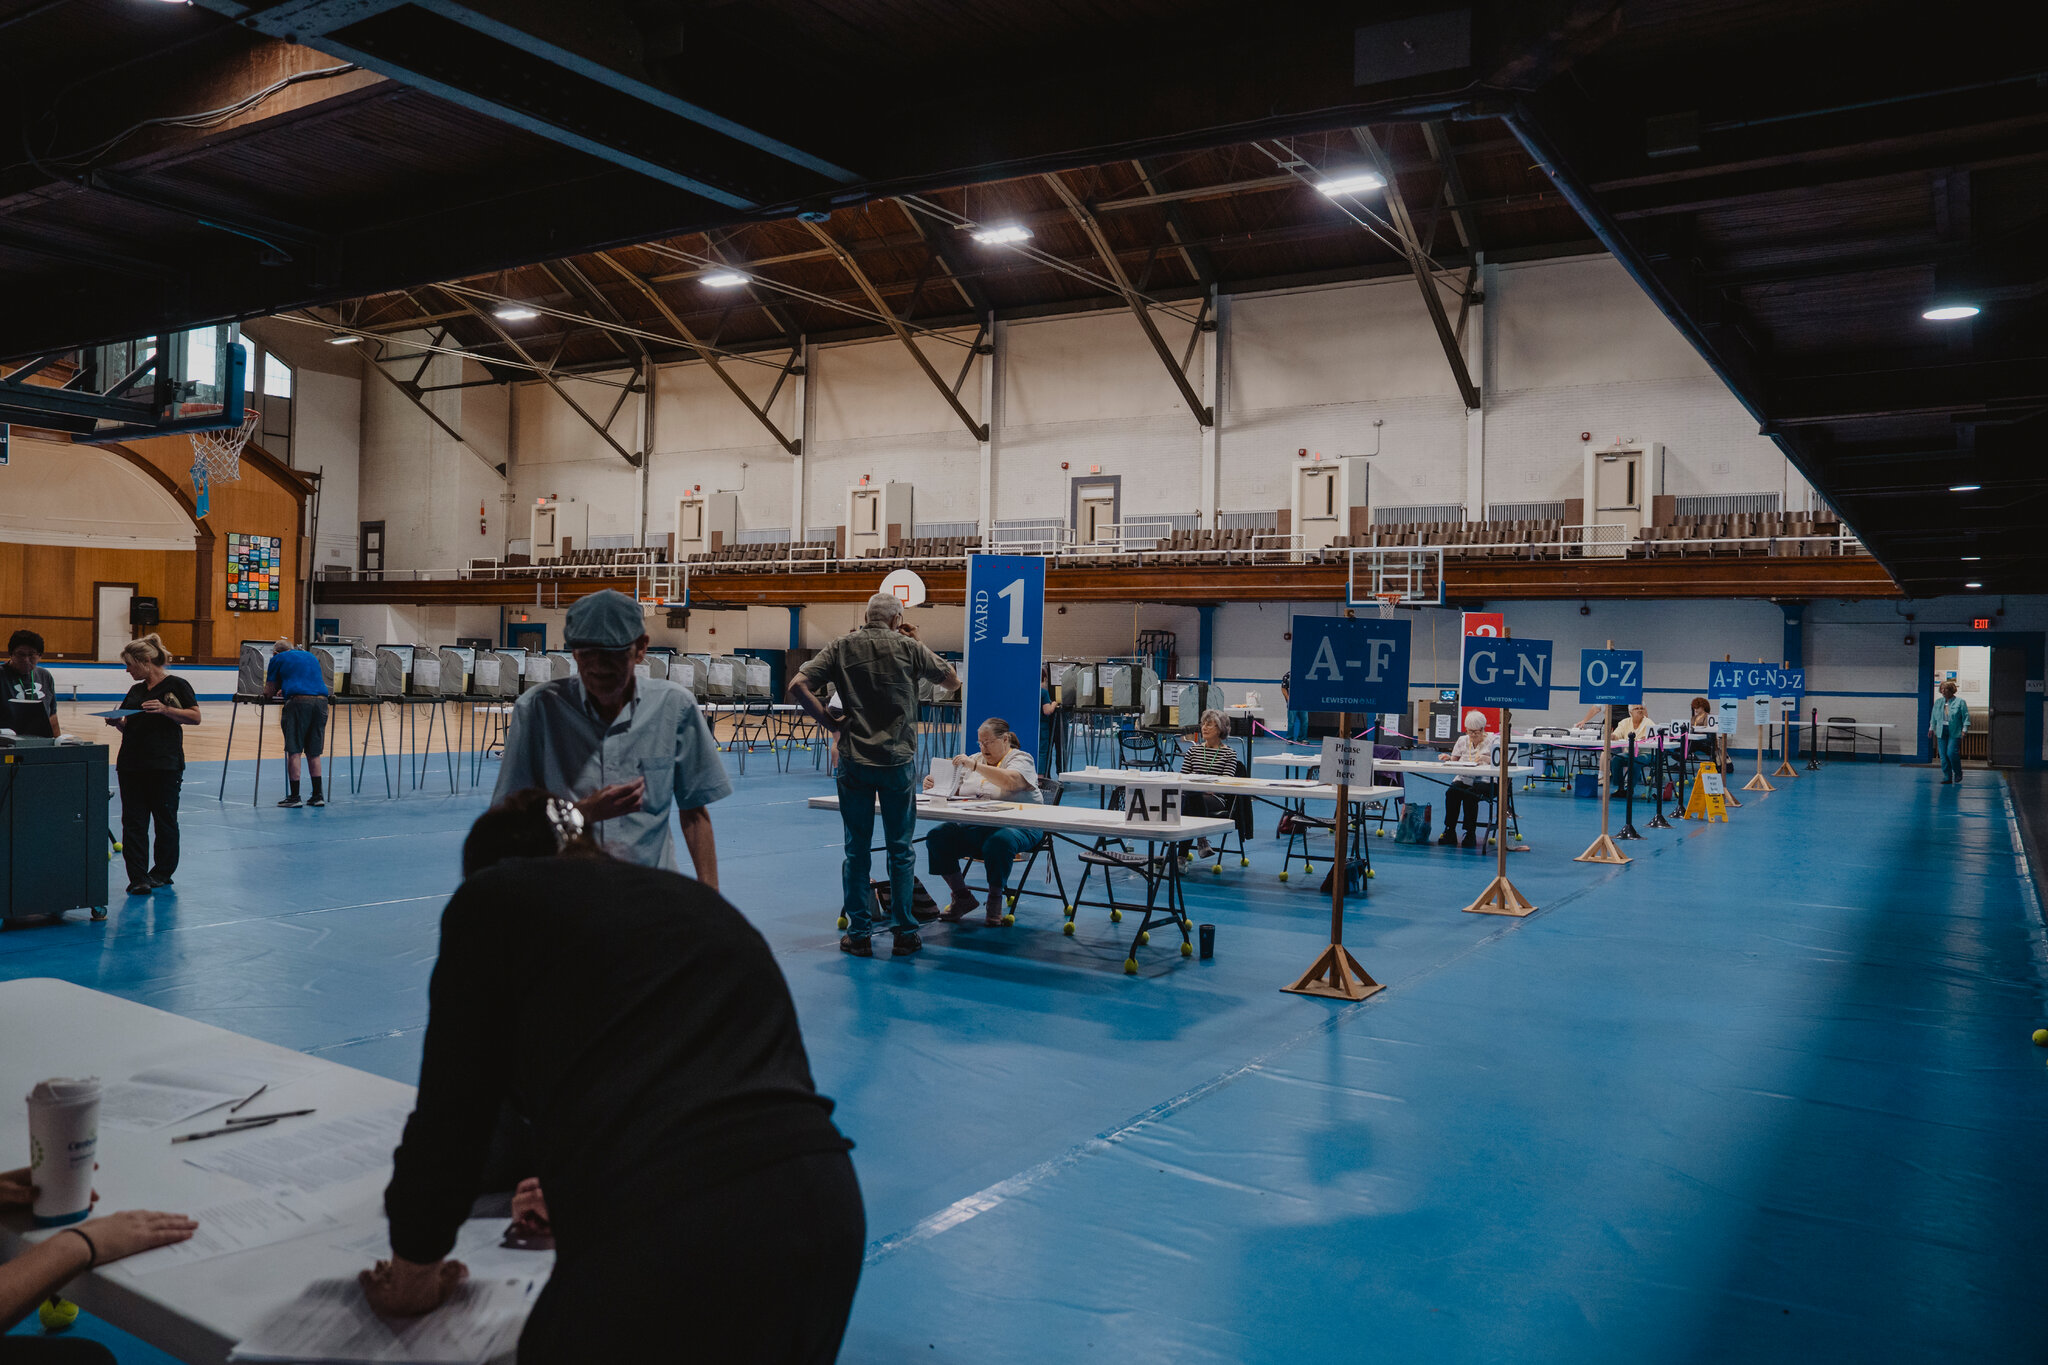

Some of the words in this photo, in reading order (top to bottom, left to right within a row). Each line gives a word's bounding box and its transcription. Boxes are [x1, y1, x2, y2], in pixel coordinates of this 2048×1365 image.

[974, 590, 989, 642] WARD
[998, 578, 1029, 645] 1
[1974, 619, 1989, 629] EXIT
[1305, 636, 1396, 682] A-F
[1468, 651, 1547, 687] G-N
[1586, 660, 1637, 687] O-Z
[1713, 669, 1744, 688] A-F
[1747, 669, 1777, 686] G-N
[1321, 696, 1359, 705] LEWISTON
[1335, 743, 1361, 754] Please
[1492, 746, 1517, 767] OZ
[1338, 757, 1355, 767] wait
[1336, 769, 1355, 779] here
[1126, 788, 1179, 822] A-F
